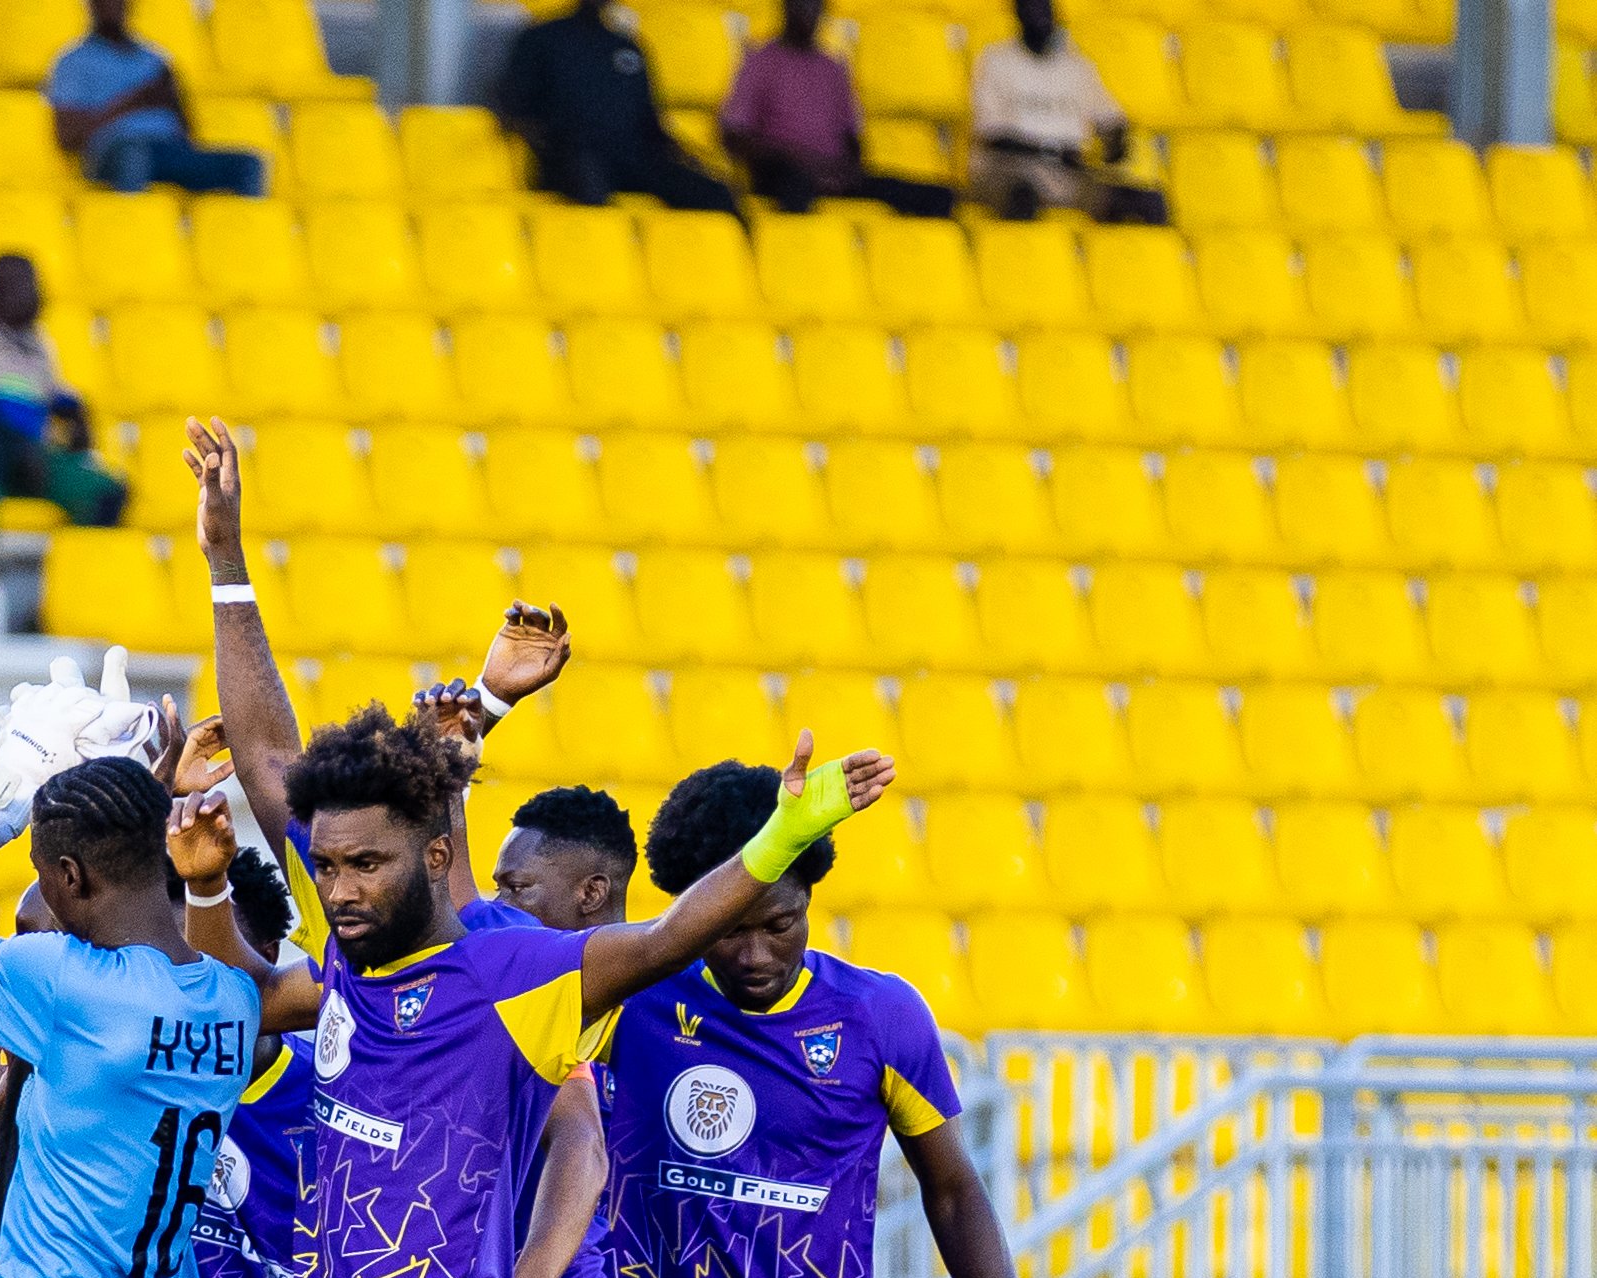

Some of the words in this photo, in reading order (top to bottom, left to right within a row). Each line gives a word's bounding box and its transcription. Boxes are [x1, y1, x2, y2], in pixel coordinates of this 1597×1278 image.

[11, 729, 50, 759] DOMINION
[146, 1016, 245, 1077] KYEI
[334, 1108, 394, 1143] FIELDS
[666, 1168, 727, 1192] GOLD
[740, 1181, 822, 1207] FIELDS
